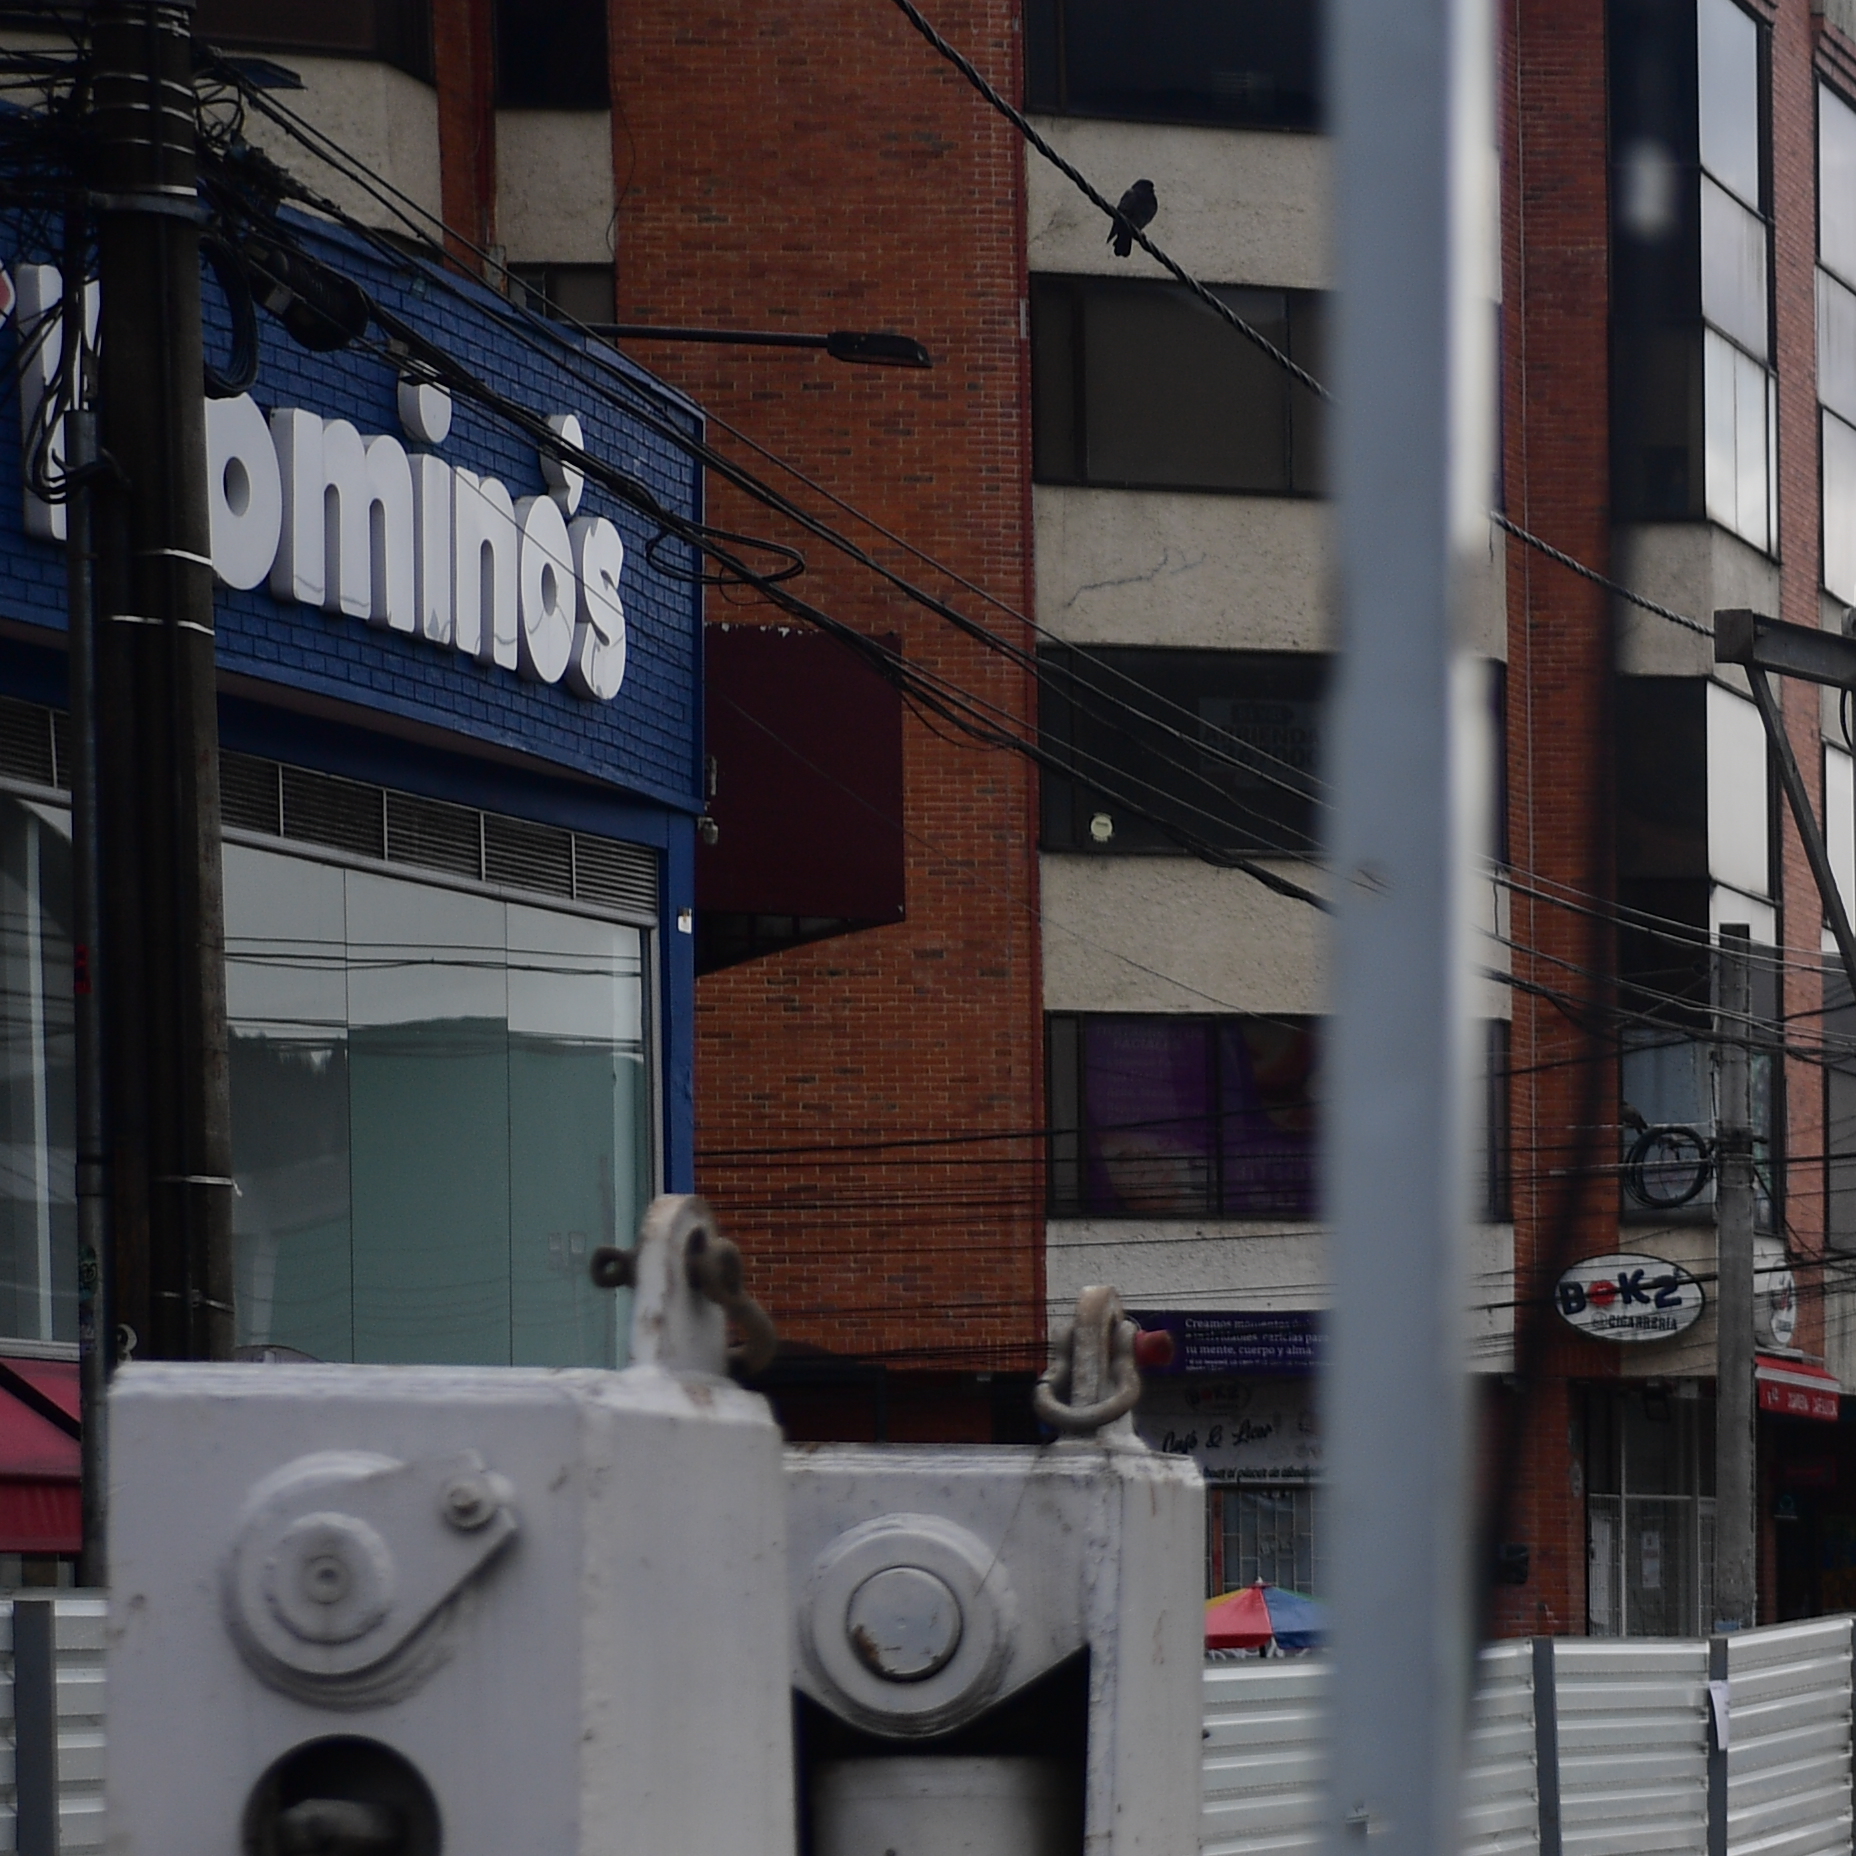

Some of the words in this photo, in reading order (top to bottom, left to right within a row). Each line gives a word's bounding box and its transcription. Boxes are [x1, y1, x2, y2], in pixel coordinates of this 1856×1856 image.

[1184, 1318, 1231, 1328] Creamos
[1199, 1345, 1236, 1355] mente,
[1238, 1346, 1275, 1357] cuerpo
[1277, 1346, 1284, 1357] y
